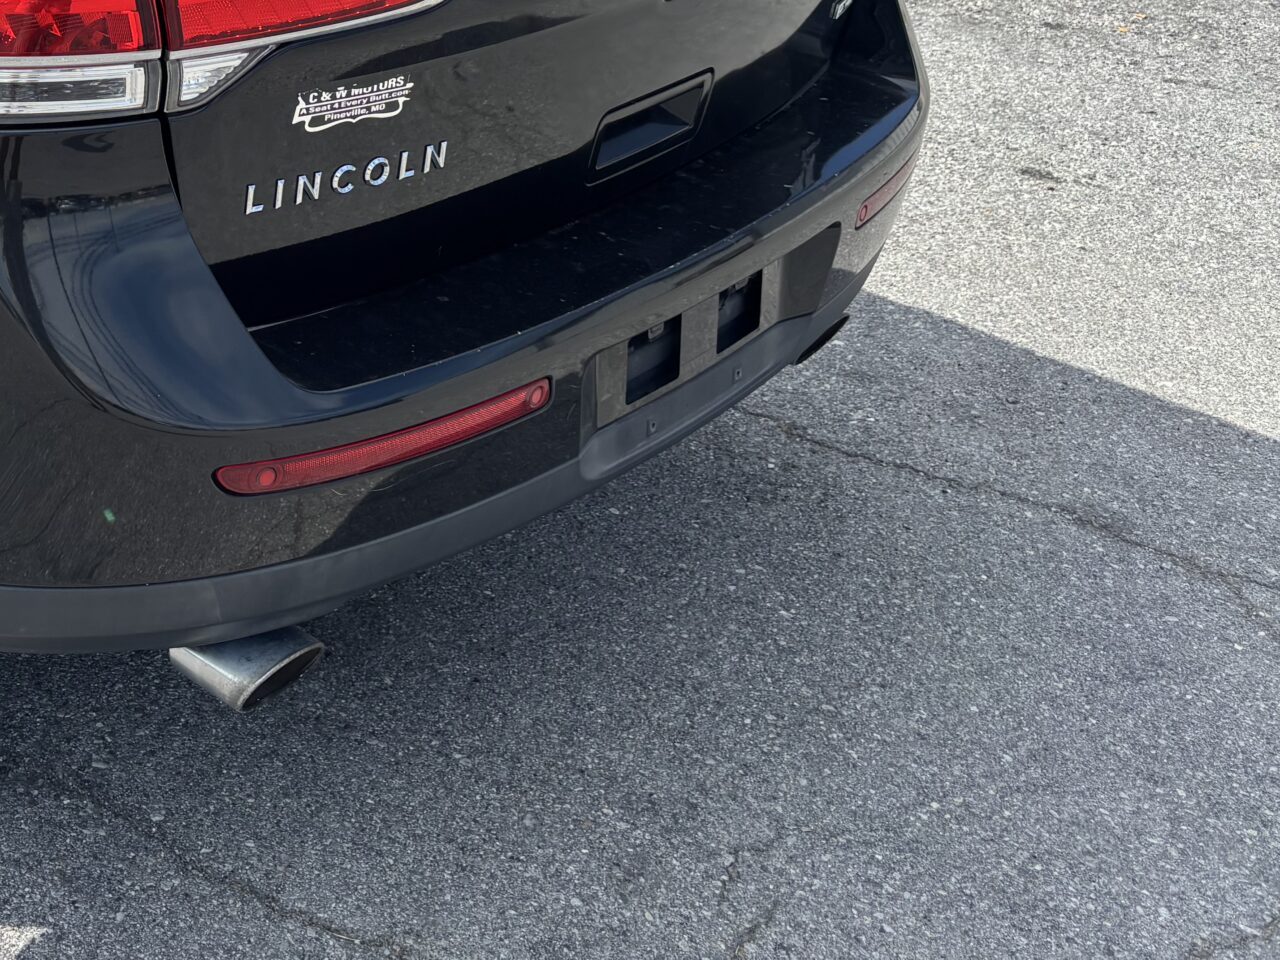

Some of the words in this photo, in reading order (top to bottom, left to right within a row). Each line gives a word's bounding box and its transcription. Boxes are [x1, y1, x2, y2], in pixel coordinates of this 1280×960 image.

[300, 107, 308, 115] A
[308, 103, 331, 114] Seat
[332, 101, 340, 109] 4
[340, 96, 368, 109] Every
[309, 92, 319, 104] C
[320, 90, 333, 101] &
[324, 108, 369, 122] Pineville,
[370, 102, 387, 113] MO
[245, 141, 448, 215] LINCOLN
